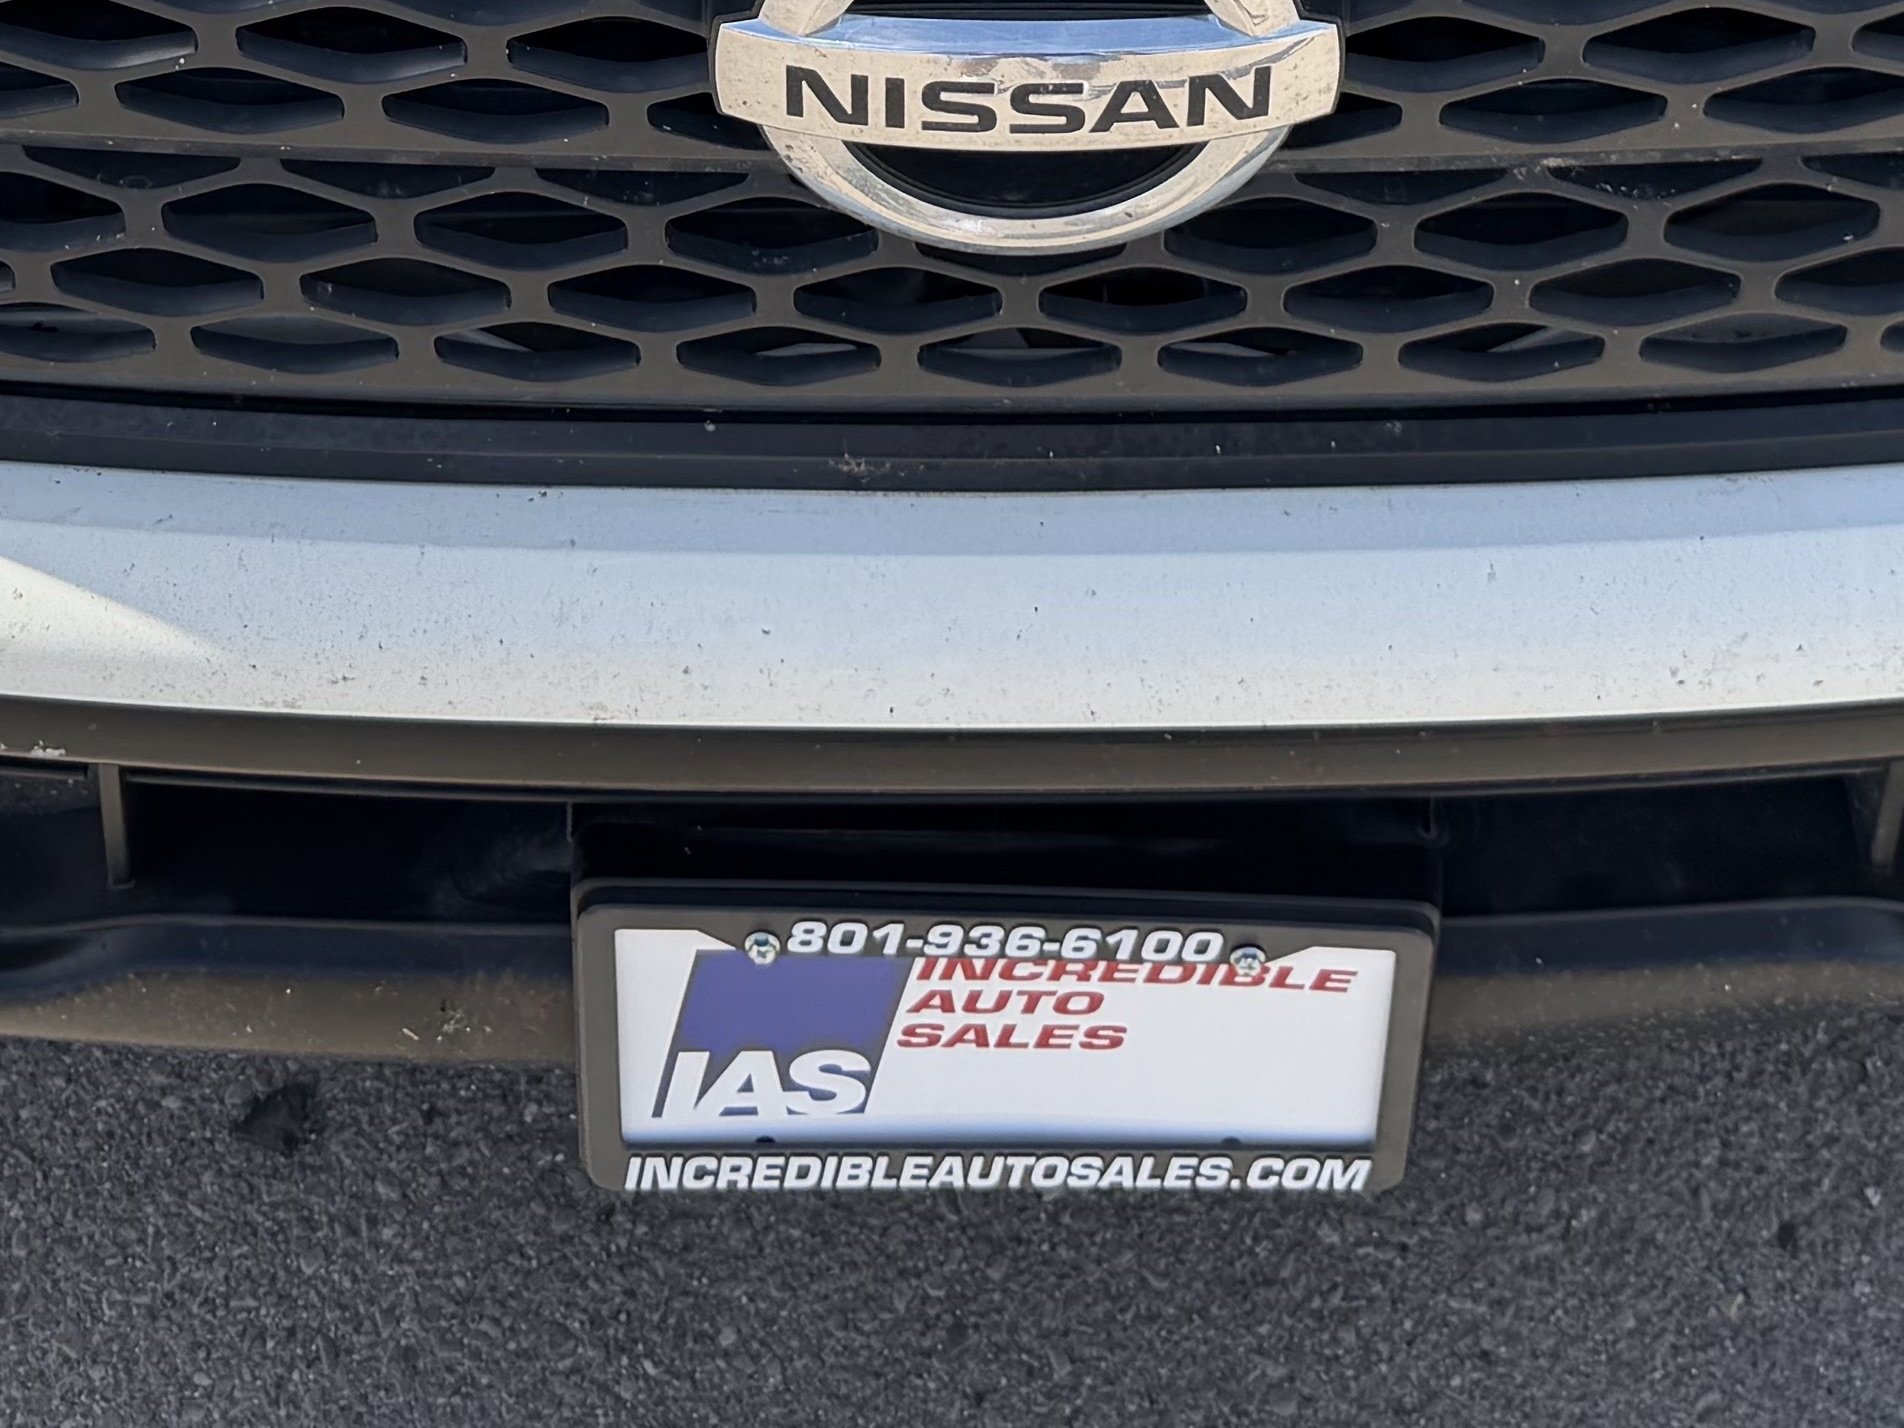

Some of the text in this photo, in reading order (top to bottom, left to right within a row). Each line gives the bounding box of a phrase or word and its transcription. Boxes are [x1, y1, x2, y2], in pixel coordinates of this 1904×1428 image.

[784, 64, 1273, 134] NISSAN
[787, 921, 1225, 963] 801-936-6100
[917, 957, 1359, 993] INCREDIBLE
[907, 989, 1105, 1015] AUTO
[897, 1023, 1128, 1049] SALES
[662, 1048, 872, 1118] IAS
[624, 1155, 1373, 1191] INCREDIBLEAUTOSALES.COM
